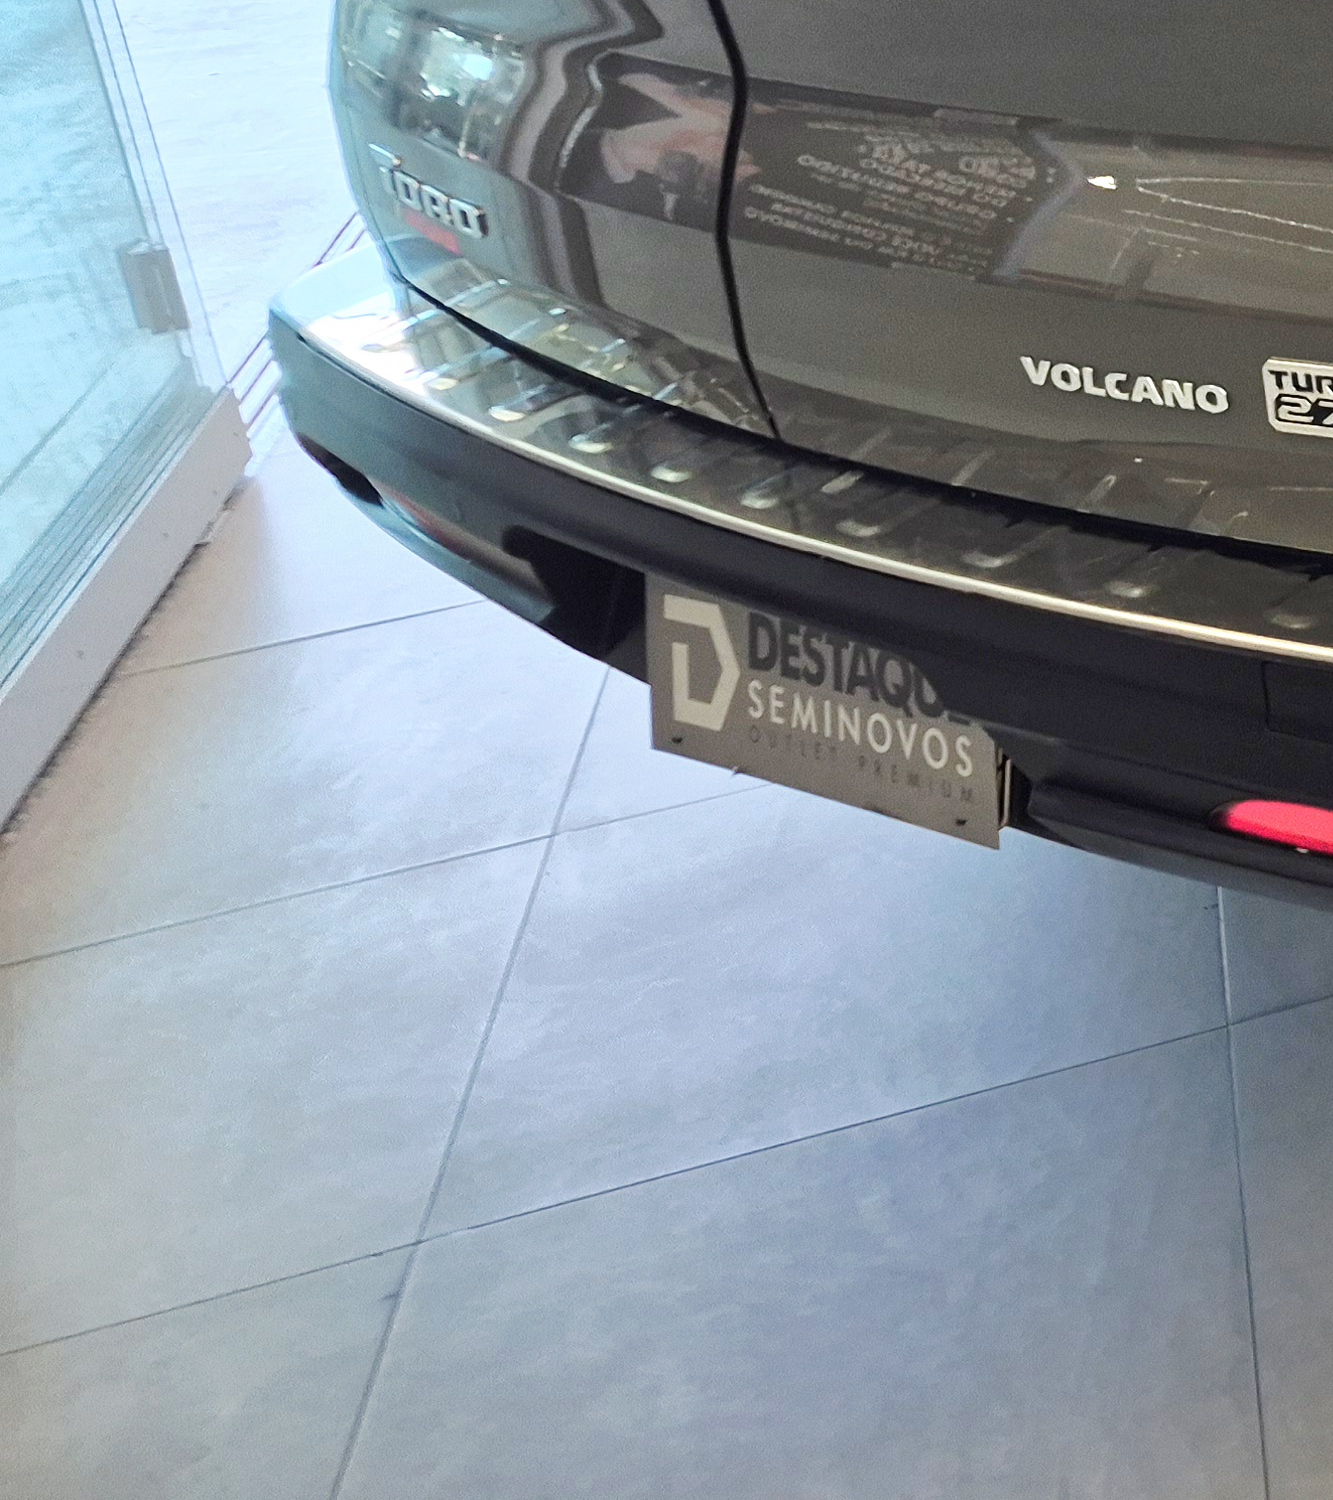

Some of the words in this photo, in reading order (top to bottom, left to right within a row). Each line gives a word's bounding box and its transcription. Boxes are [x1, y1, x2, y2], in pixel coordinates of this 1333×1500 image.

[367, 142, 489, 239] TORO
[1020, 356, 1229, 415] VOLCANO
[748, 610, 972, 726] DESTAQU
[748, 679, 974, 777] SEMINOVOS
